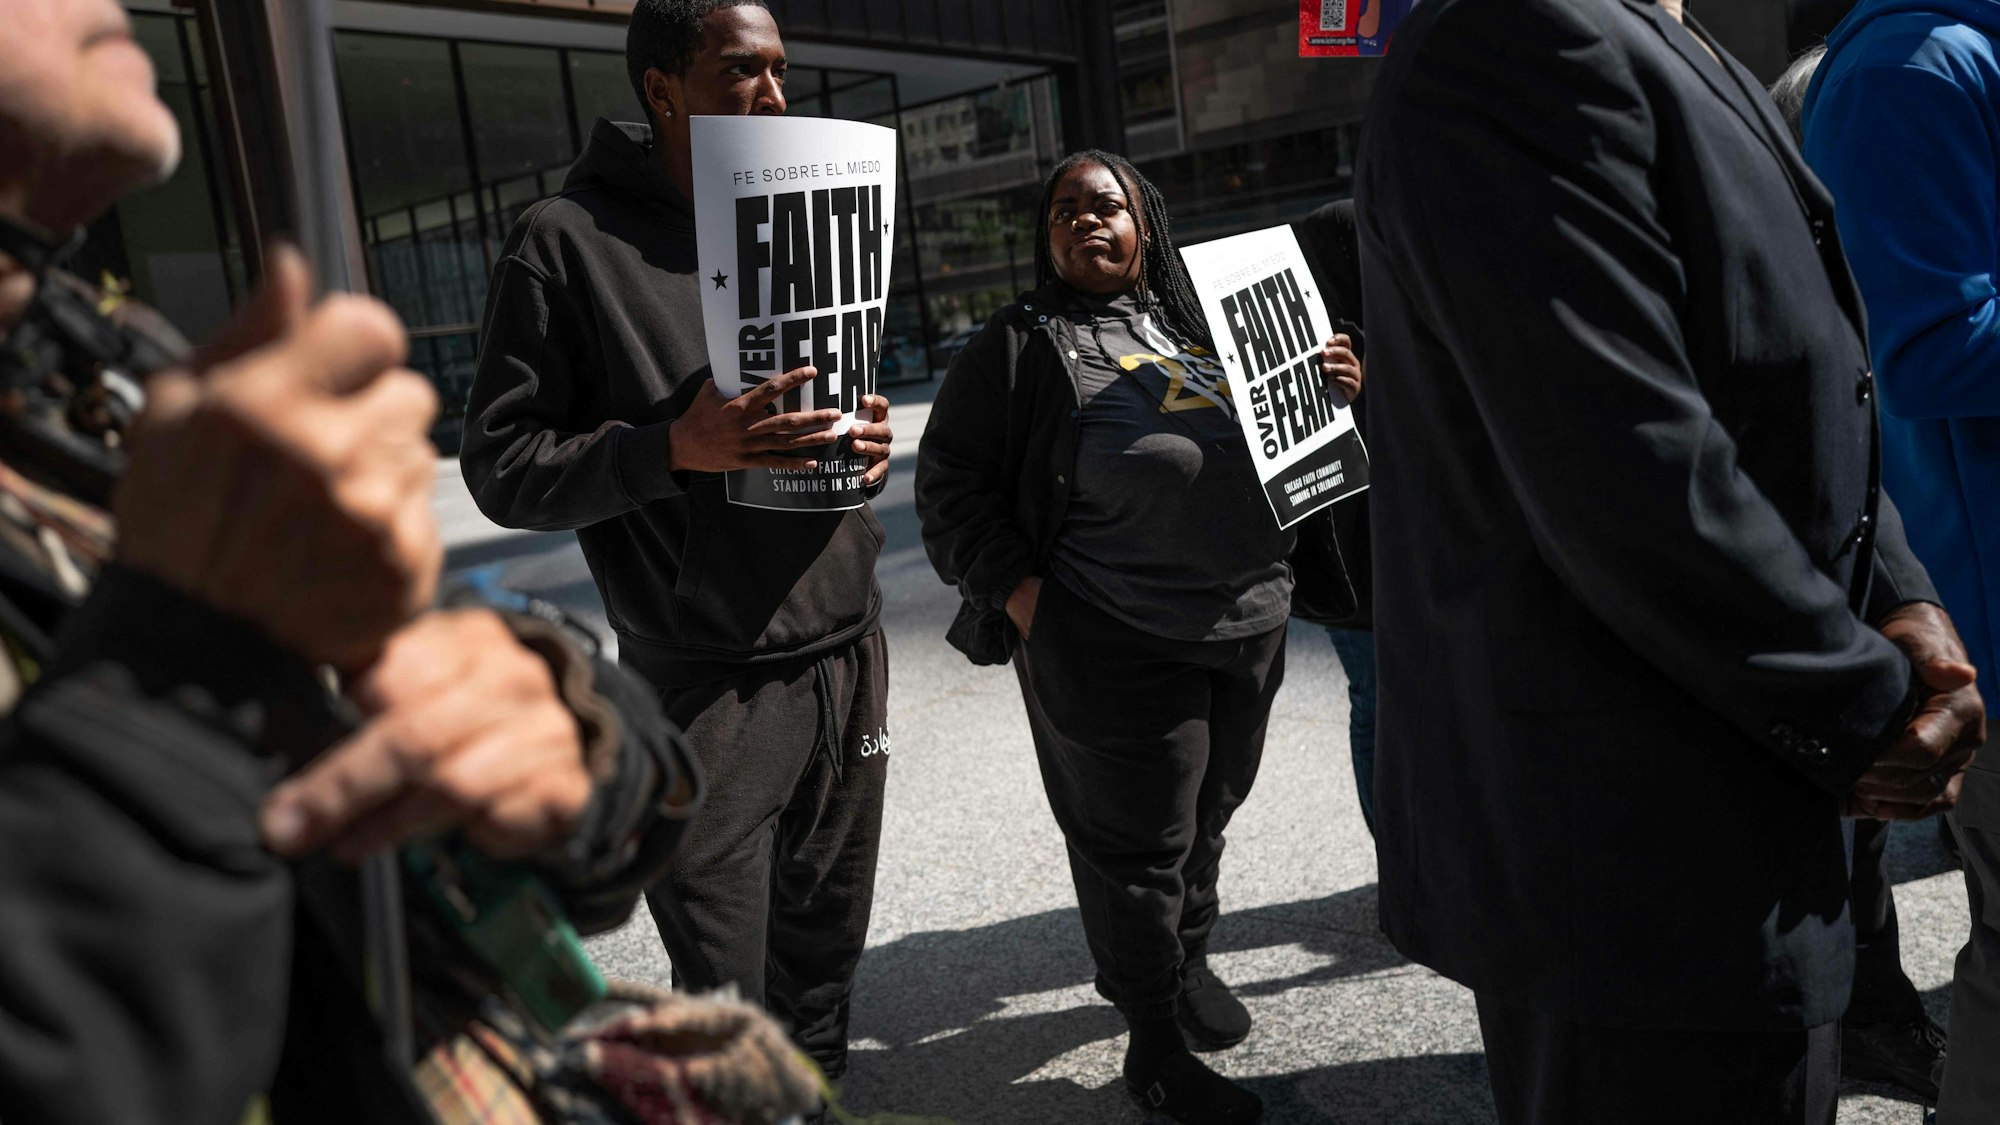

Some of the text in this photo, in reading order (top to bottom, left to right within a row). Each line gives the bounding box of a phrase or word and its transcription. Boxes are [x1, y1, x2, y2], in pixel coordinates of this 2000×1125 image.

[733, 160, 881, 186] FE SOBRE EL MIEDO
[735, 184, 882, 320] FAITH
[781, 306, 882, 415] FEAR
[1220, 267, 1319, 383] FAITH
[739, 323, 778, 415] VER
[1266, 352, 1336, 453] FEAR
[1249, 382, 1279, 460] OVER
[773, 479, 827, 492] STANDING
[831, 478, 842, 491] IN
[818, 460, 846, 474] FAITH
[1284, 459, 1342, 494] CHICAGO FAITH COMMUNITY
[1289, 472, 1344, 507] STANDING IN SOLIDARITY
